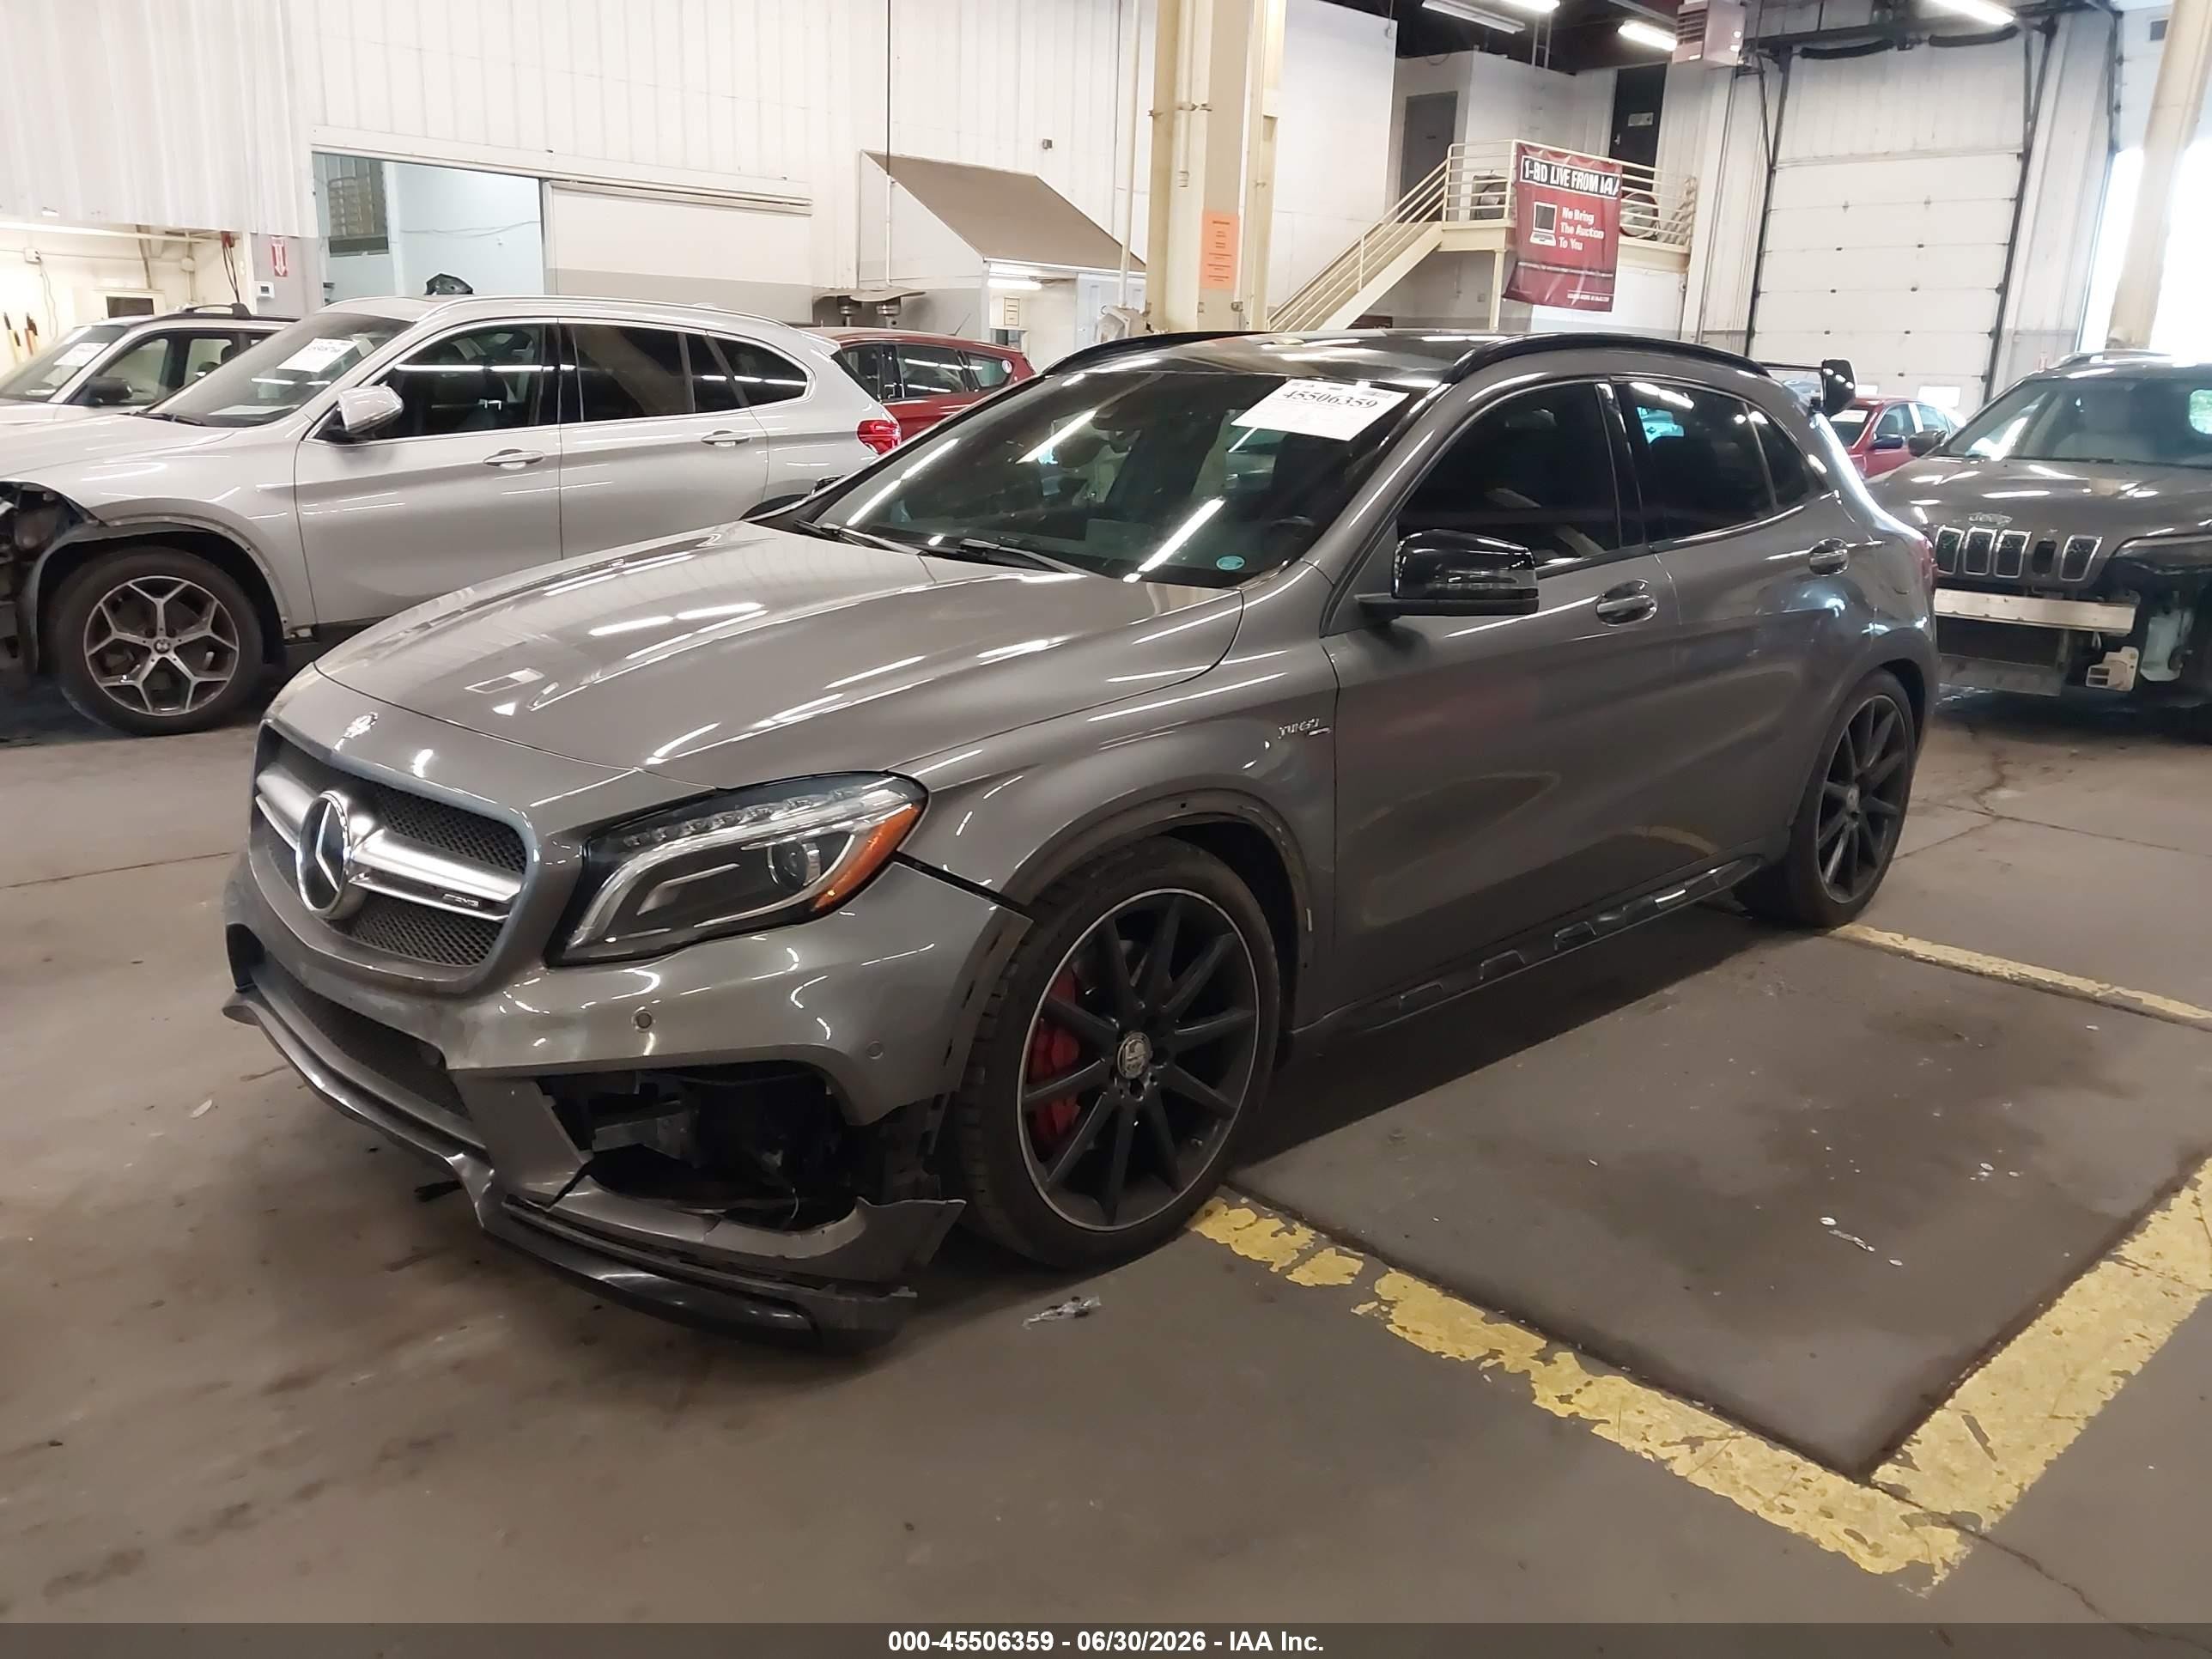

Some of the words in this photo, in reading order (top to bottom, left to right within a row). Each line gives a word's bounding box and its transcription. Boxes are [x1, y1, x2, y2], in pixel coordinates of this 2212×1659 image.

[1550, 166, 1571, 187] LIVE
[1571, 171, 1600, 193] FROM
[1573, 209, 1595, 225] Bring
[1560, 222, 1575, 234] The
[1575, 224, 1605, 240] Auction
[1559, 236, 1569, 249] To
[1570, 238, 1583, 251] You
[1284, 391, 1378, 409] 45506359
